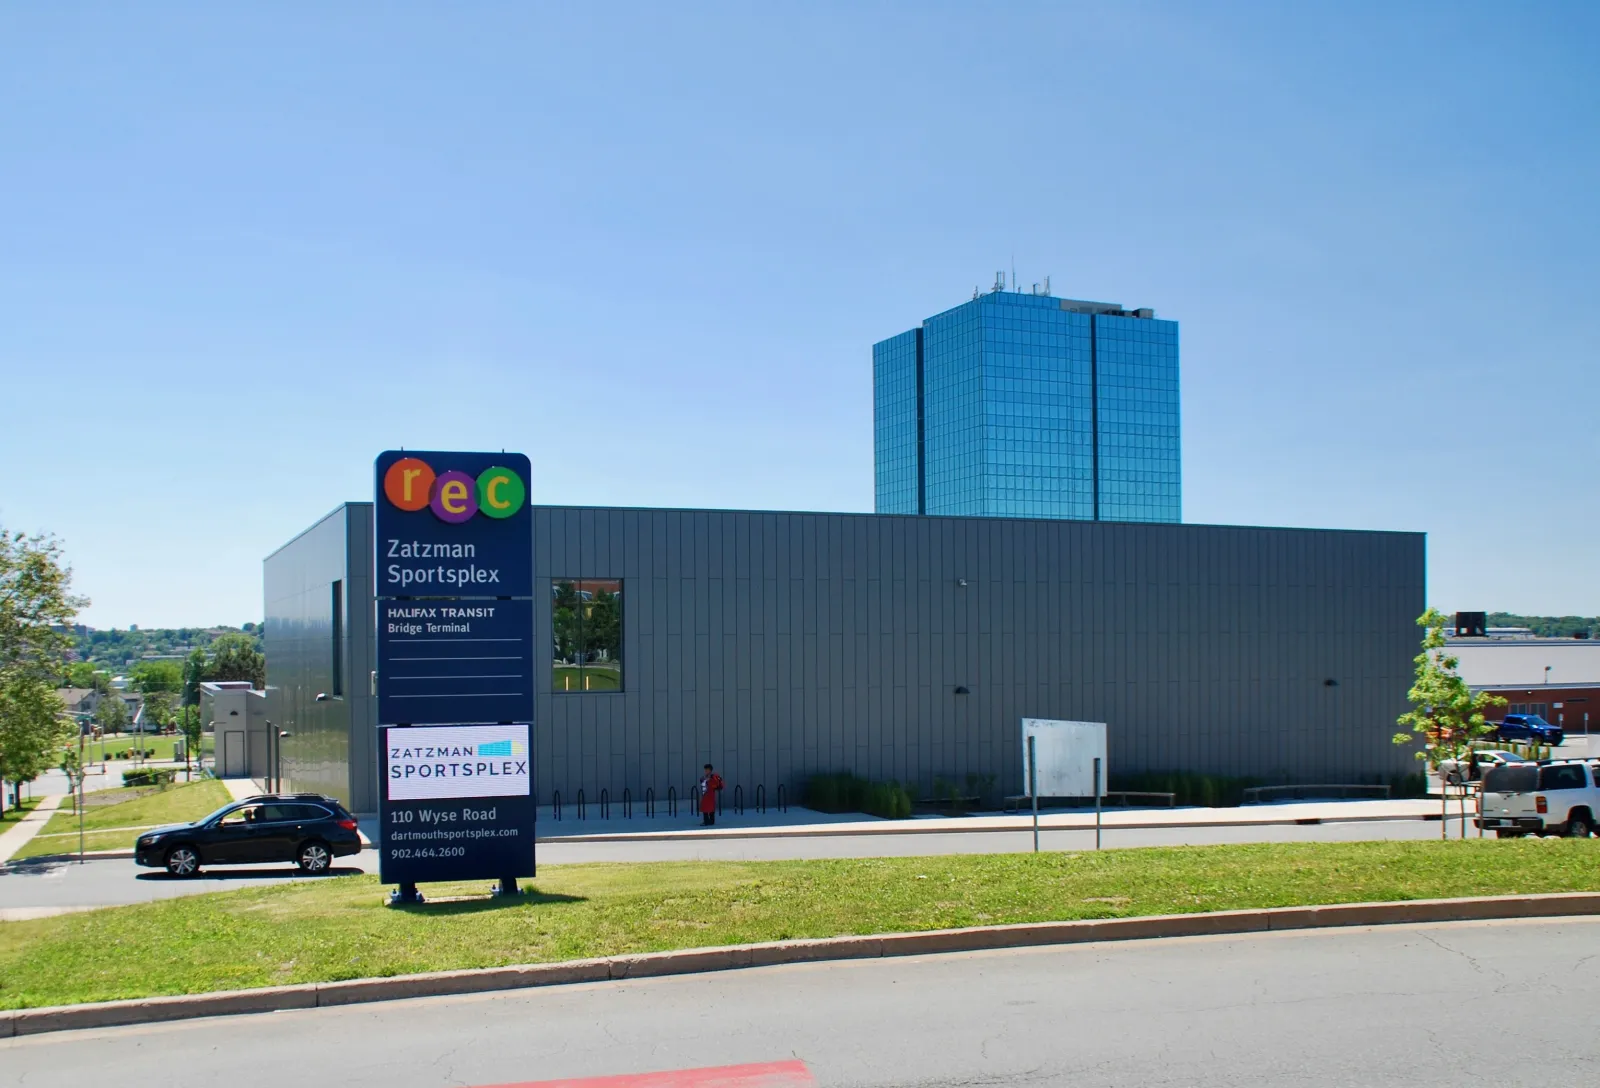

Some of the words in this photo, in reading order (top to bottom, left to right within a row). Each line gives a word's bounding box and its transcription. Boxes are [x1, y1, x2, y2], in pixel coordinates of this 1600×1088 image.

[403, 468, 511, 514] rec
[387, 539, 476, 558] Zatzman
[388, 564, 499, 587] Sportsplex
[388, 608, 436, 618] HALIFAX
[441, 608, 495, 618] TRANSIT
[388, 623, 423, 635] Bridge
[426, 622, 471, 633] Terminal
[391, 747, 473, 758] ZATZMAN
[391, 761, 527, 778] SPORTSPLEX
[391, 811, 413, 823] 110
[418, 809, 457, 825] Wyse
[463, 807, 497, 821] Road
[391, 828, 518, 841] dartmouthsportsplex.com
[391, 847, 465, 859] 902.464.2600
